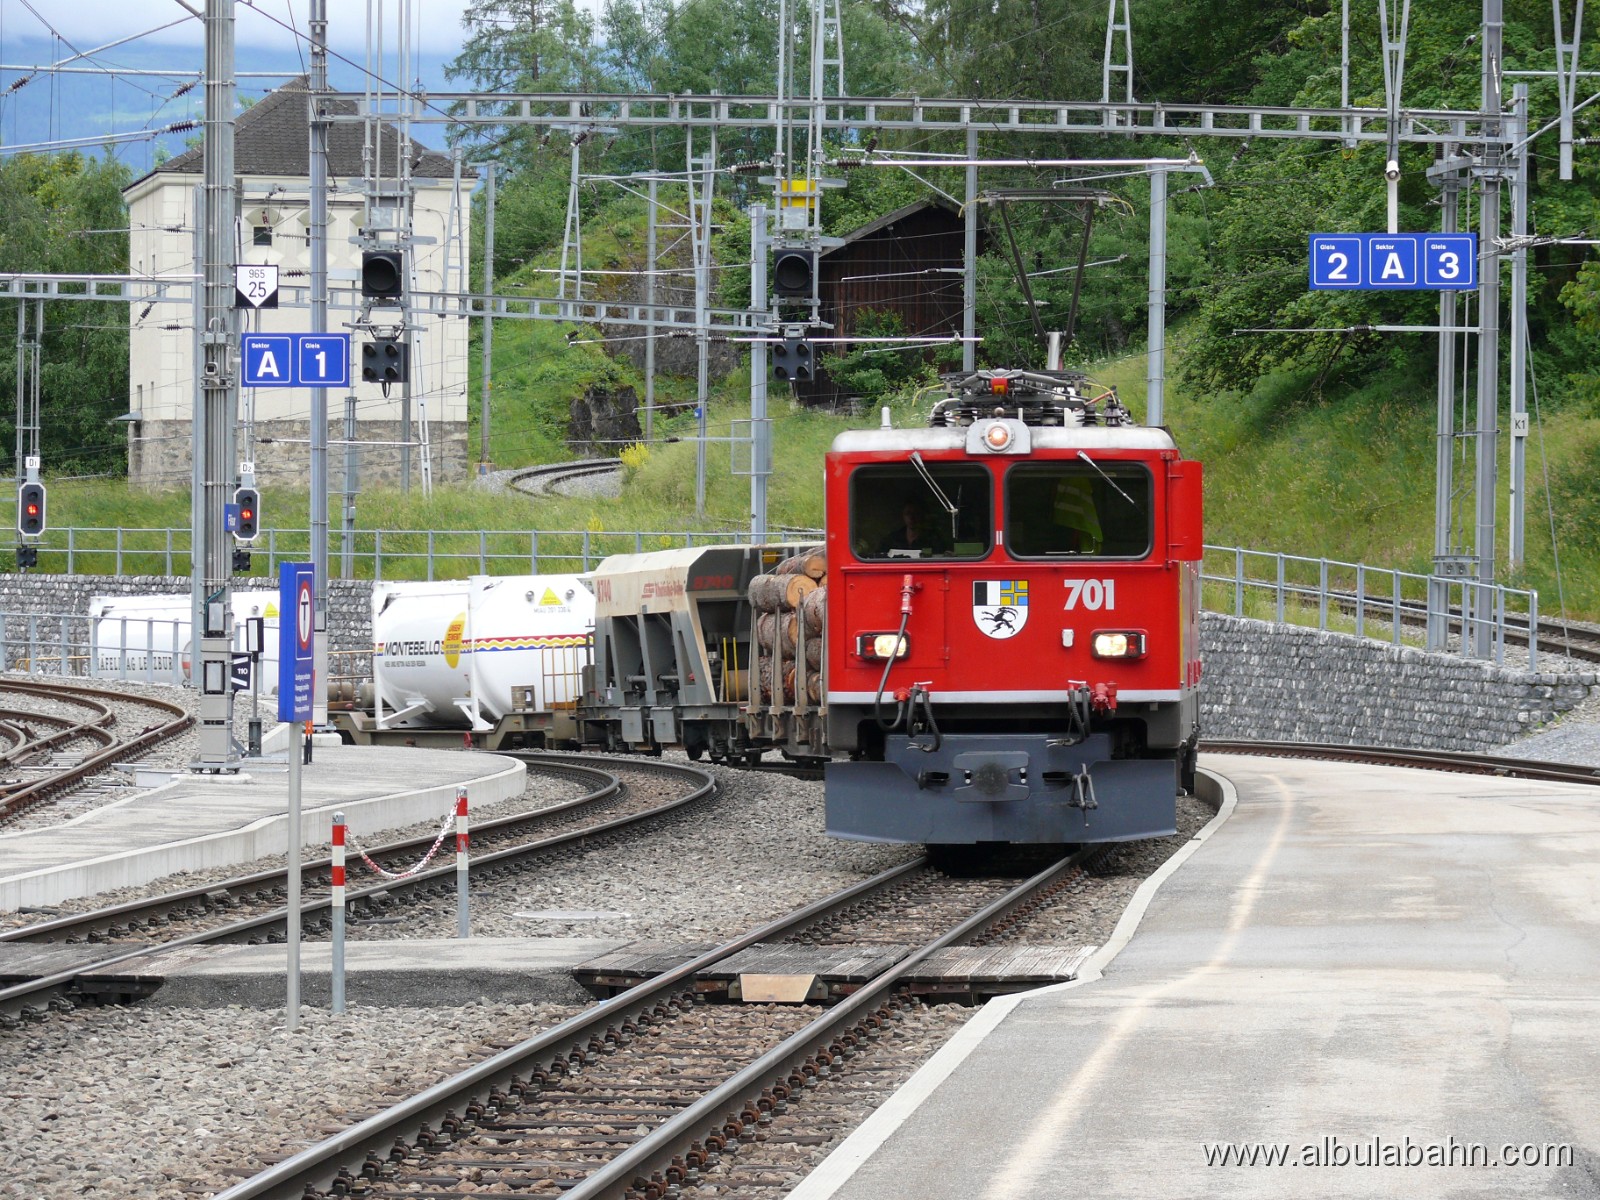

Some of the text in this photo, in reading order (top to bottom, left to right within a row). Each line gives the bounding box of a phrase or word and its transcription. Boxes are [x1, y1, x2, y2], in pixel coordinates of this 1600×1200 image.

[248, 269, 265, 279] 965
[1328, 252, 1460, 280] 2 A 3
[249, 281, 267, 298] 25
[257, 351, 326, 378] A 1
[1514, 419, 1526, 430] K1
[693, 575, 734, 590] 8740
[1063, 578, 1115, 611] 701
[385, 640, 440, 657] MONTEBELLO
[236, 667, 249, 675] 110
